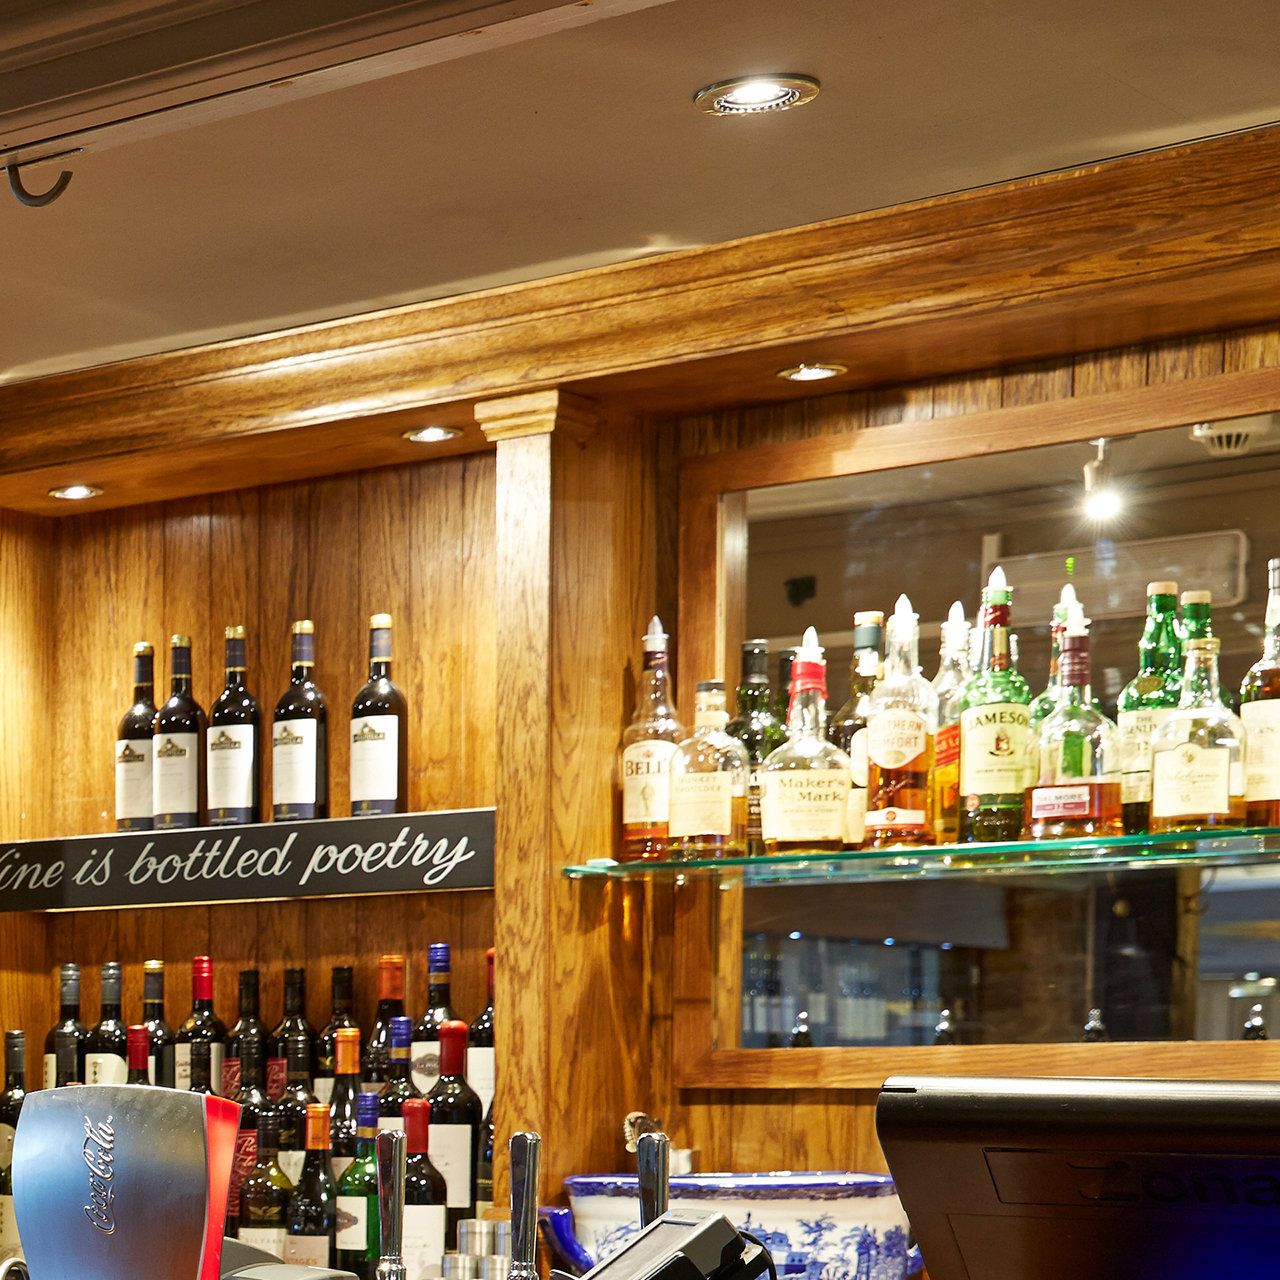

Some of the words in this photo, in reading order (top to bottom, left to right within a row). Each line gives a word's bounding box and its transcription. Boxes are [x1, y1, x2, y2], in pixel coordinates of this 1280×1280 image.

[780, 779, 845, 788] Maker's
[799, 792, 844, 801] Mark
[72, 849, 114, 888] is
[124, 832, 298, 887] bottled
[299, 826, 476, 886] poetry
[82, 1114, 116, 1235] Coca-Cola
